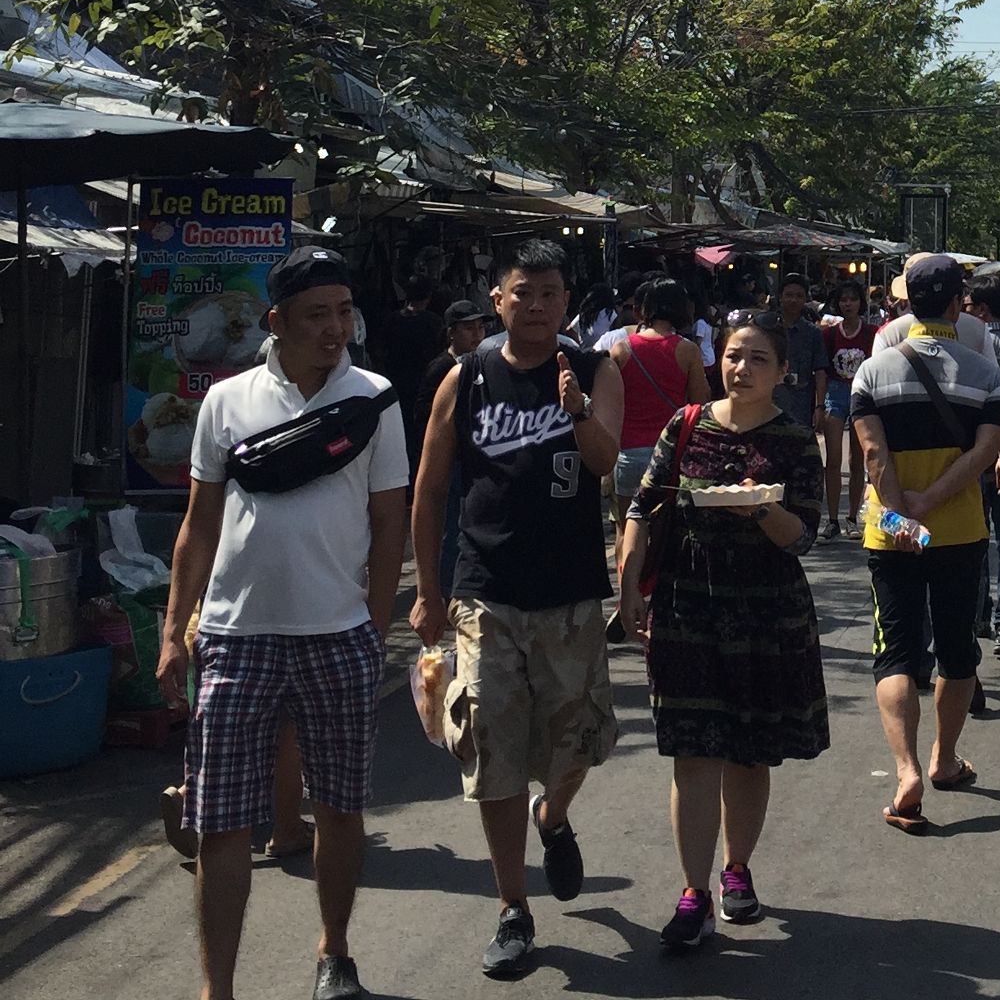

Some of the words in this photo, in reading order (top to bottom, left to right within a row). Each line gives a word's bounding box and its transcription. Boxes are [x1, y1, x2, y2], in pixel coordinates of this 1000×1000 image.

[149, 187, 193, 216] Ice
[200, 187, 286, 216] Cream
[184, 222, 286, 247] Coconut
[141, 250, 175, 265] Whole
[177, 250, 223, 265] Coconut
[140, 268, 171, 296] ฟรี
[137, 302, 167, 318] Free
[136, 318, 190, 336] Topping
[188, 372, 213, 393] 50
[472, 401, 572, 445] Kings
[550, 450, 582, 499] 9
